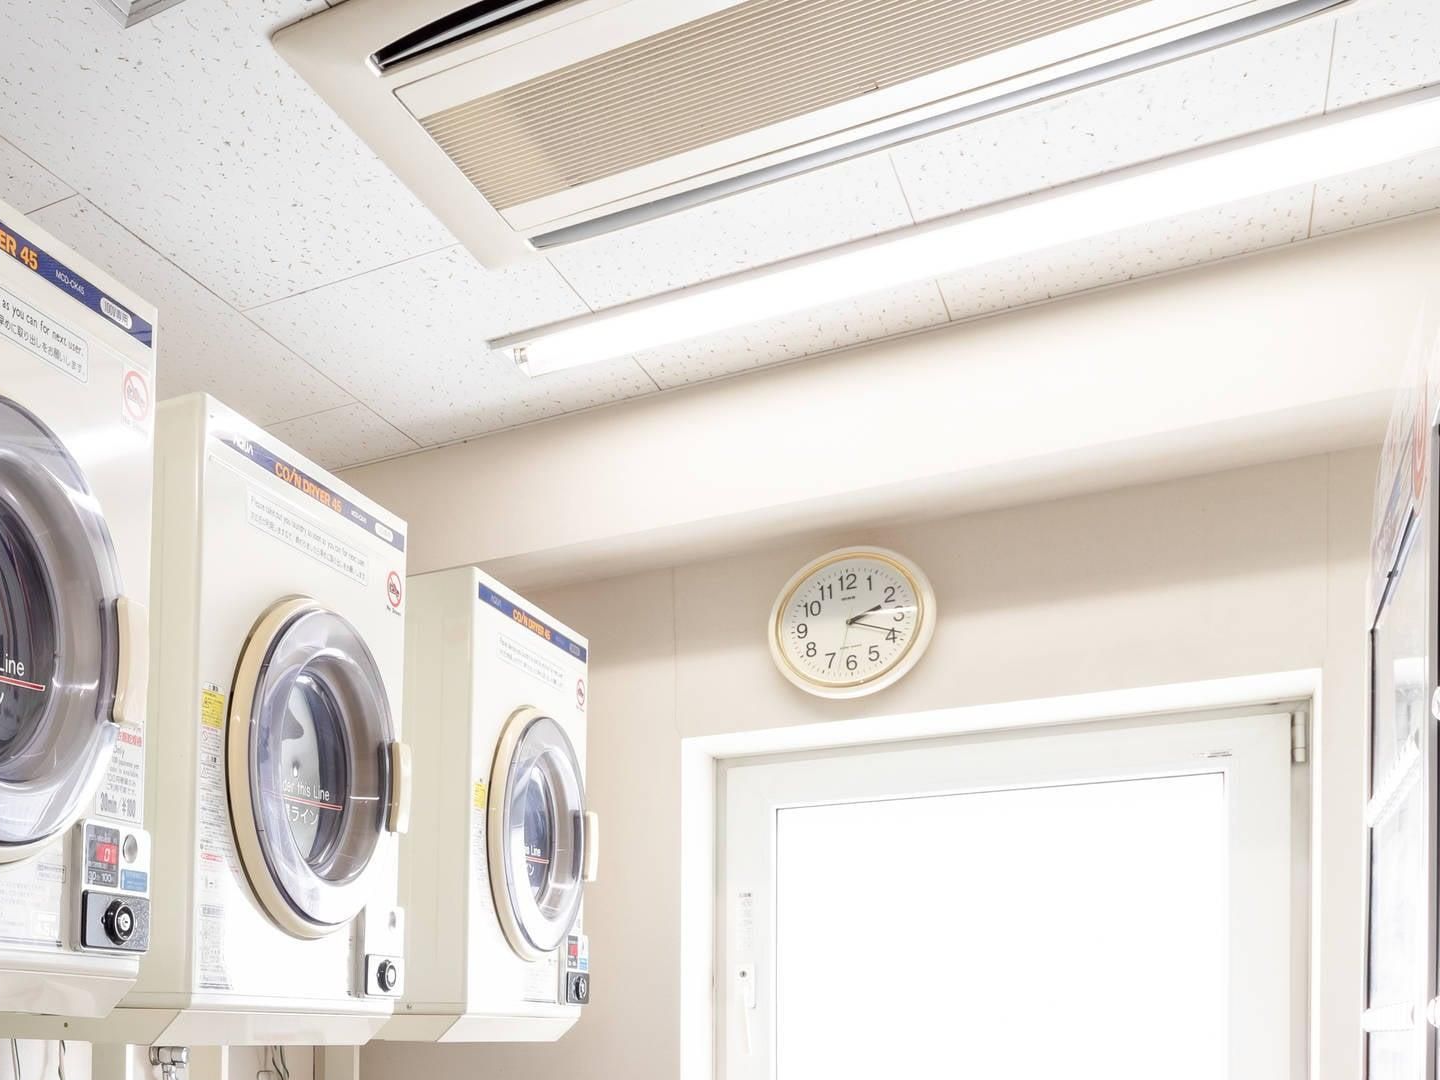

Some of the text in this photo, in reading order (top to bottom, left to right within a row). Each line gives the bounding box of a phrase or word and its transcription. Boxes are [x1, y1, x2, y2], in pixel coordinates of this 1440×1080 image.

[20, 246, 38, 270] 45
[2, 299, 10, 311] as
[12, 306, 25, 320] you
[26, 314, 38, 329] can
[40, 320, 50, 336] for
[275, 463, 343, 514] COIN DRYER 45
[838, 573, 857, 591] 12
[866, 575, 873, 591] 1
[819, 584, 833, 601] 11
[884, 586, 896, 603] 2
[803, 601, 821, 618] 10
[796, 623, 808, 639] 9
[885, 628, 897, 643] 4
[806, 642, 817, 657] 8
[868, 645, 880, 662] 5
[825, 652, 836, 669] 7
[846, 655, 857, 671] 6
[313, 784, 330, 801] Line
[285, 803, 319, 825] ライン
